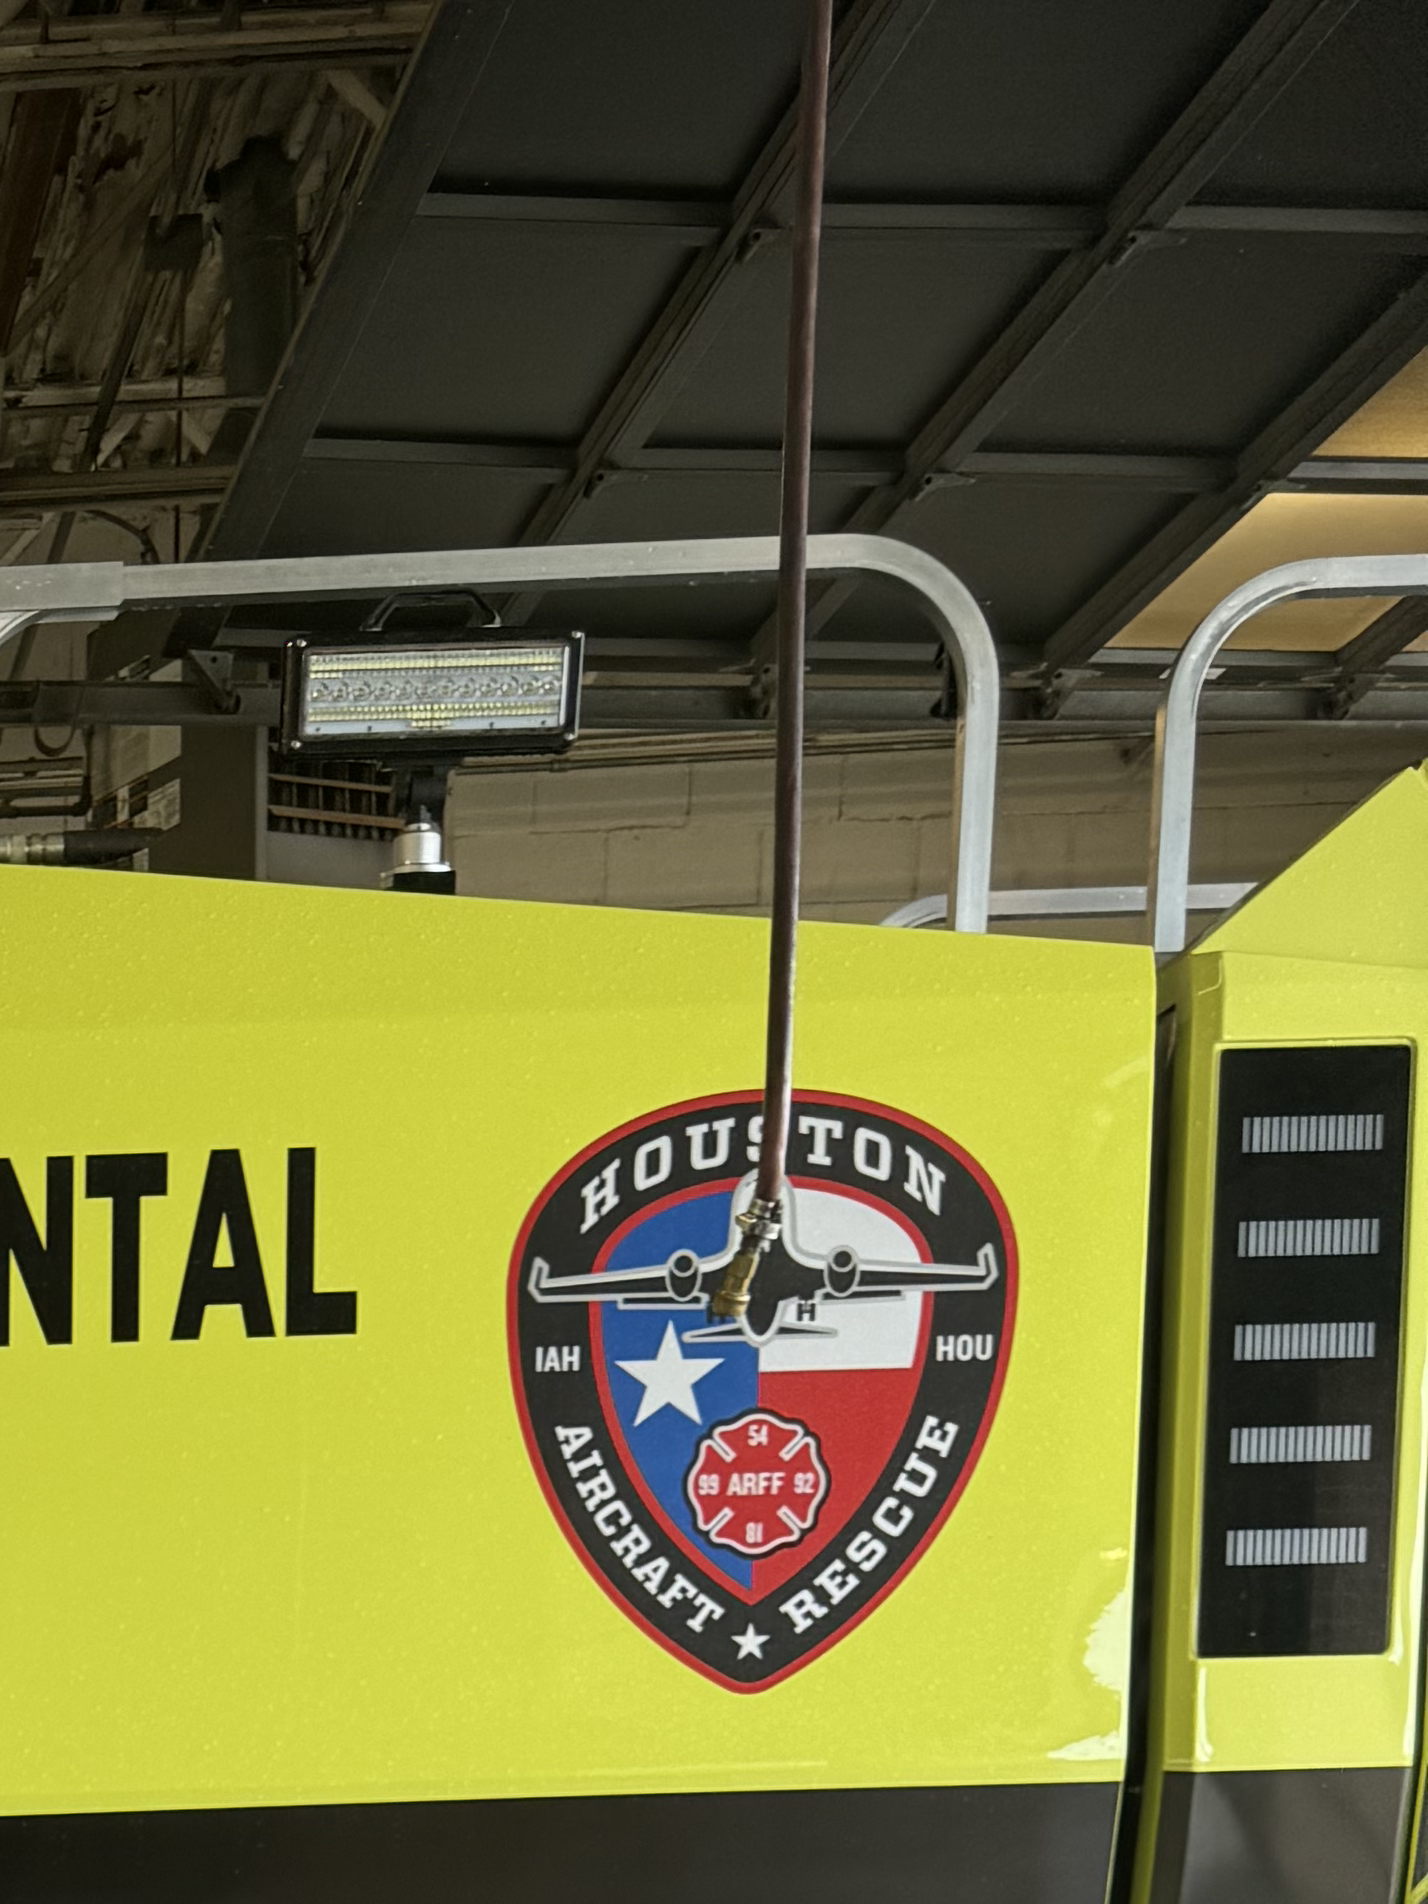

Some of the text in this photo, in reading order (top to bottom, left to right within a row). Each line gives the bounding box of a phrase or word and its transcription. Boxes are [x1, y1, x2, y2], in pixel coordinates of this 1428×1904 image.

[535, 1346, 580, 1372] IAH
[936, 1335, 993, 1362] HOU
[747, 1424, 769, 1446] 54
[726, 1472, 786, 1496] ARFF
[793, 1472, 815, 1494] 92
[555, 1415, 959, 1634] AIRCRAFT RESCUE
